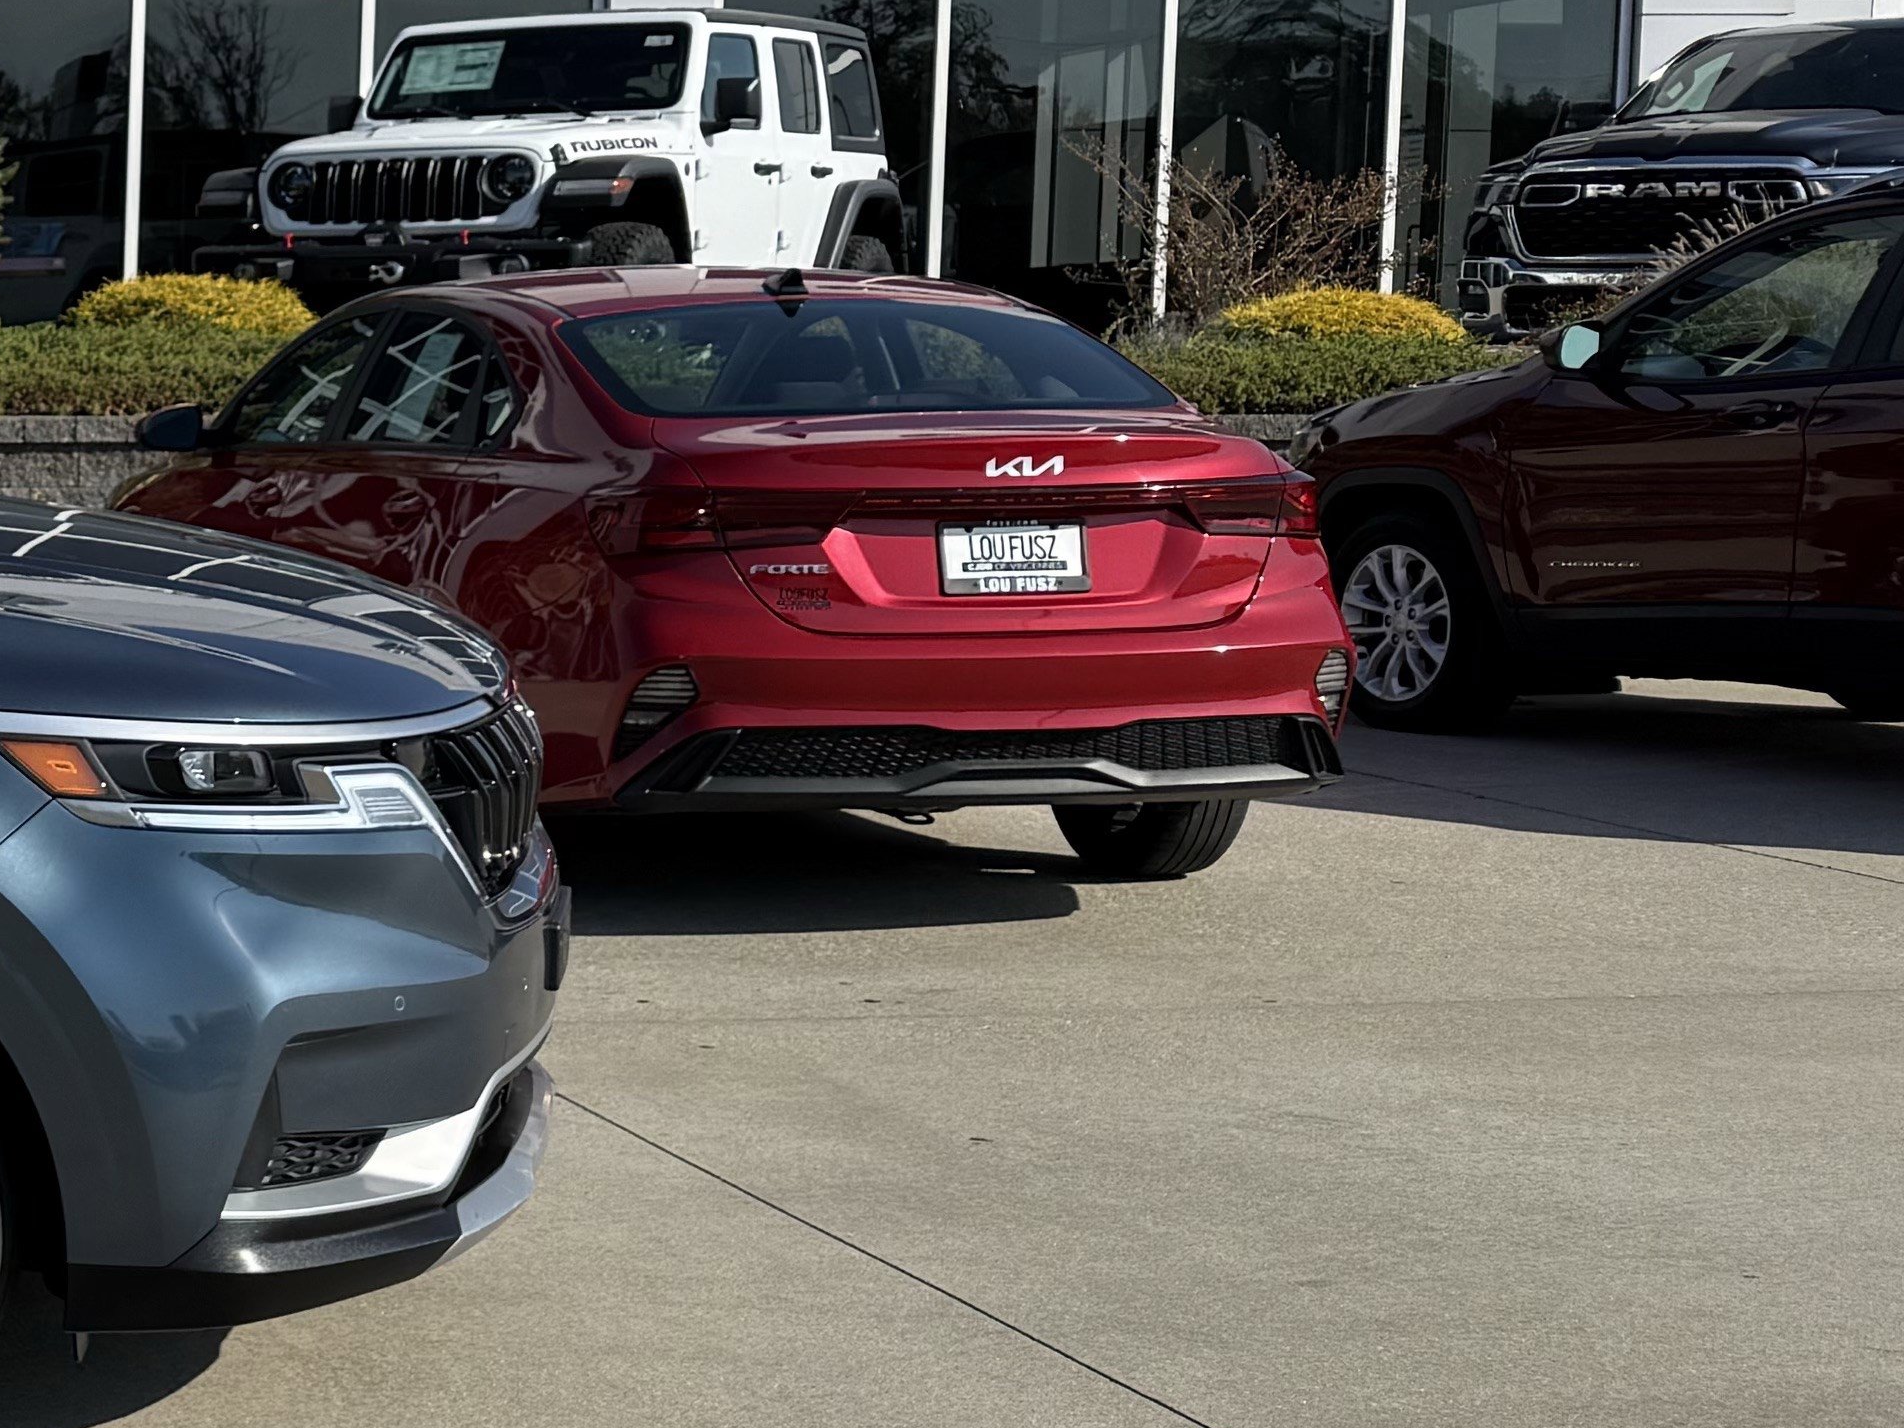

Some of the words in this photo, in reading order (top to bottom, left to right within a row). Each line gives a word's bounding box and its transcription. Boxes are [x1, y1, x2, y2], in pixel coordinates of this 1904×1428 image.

[570, 137, 658, 153] RUBICON
[1585, 181, 1722, 198] RAM
[985, 455, 1065, 478] KIA
[968, 534, 1005, 561] LOU
[1008, 534, 1059, 561] FUSZ
[749, 563, 830, 575] FORTE
[979, 577, 1012, 593] LOU
[1015, 576, 1059, 592] FUSZ
